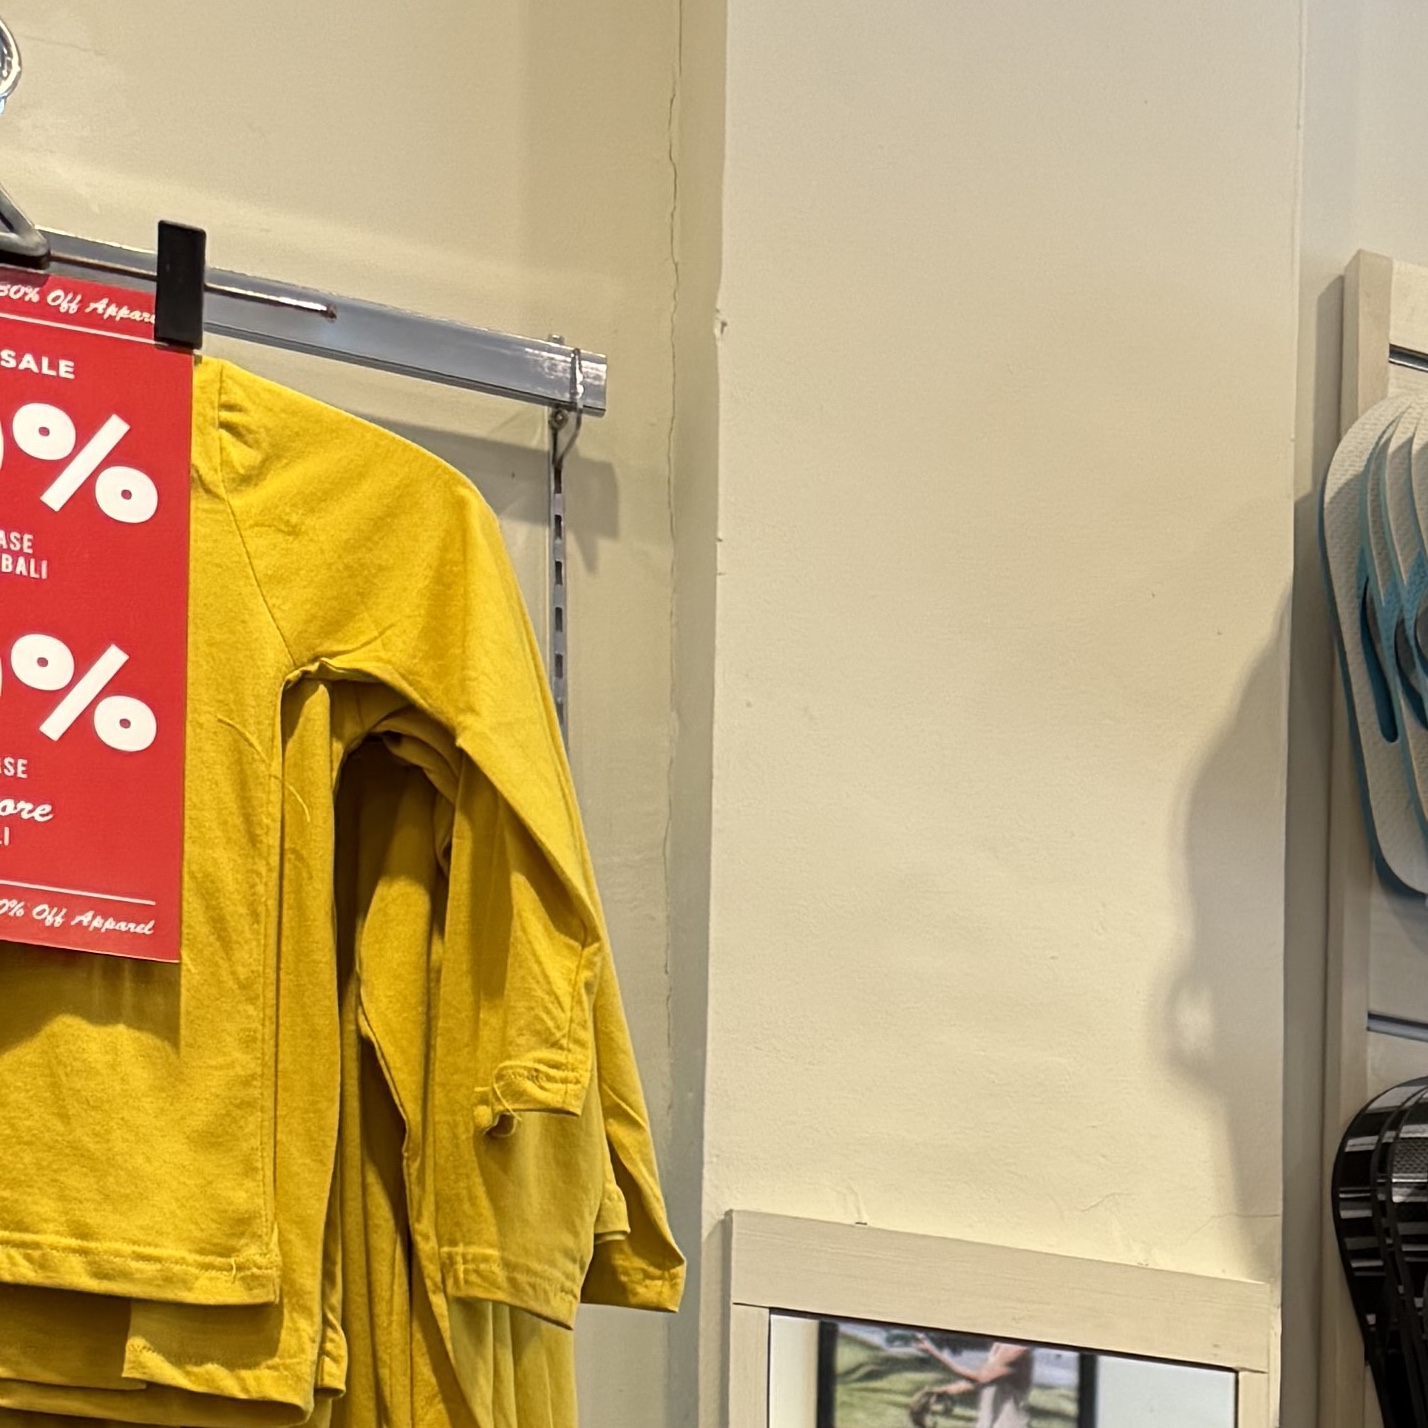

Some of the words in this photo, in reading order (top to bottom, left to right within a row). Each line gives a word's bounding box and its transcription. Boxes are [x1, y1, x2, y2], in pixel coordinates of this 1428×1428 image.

[46, 288, 82, 315] Off
[0, 348, 76, 380] SALE
[32, 903, 66, 928] Off
[70, 911, 155, 936] Apparel
